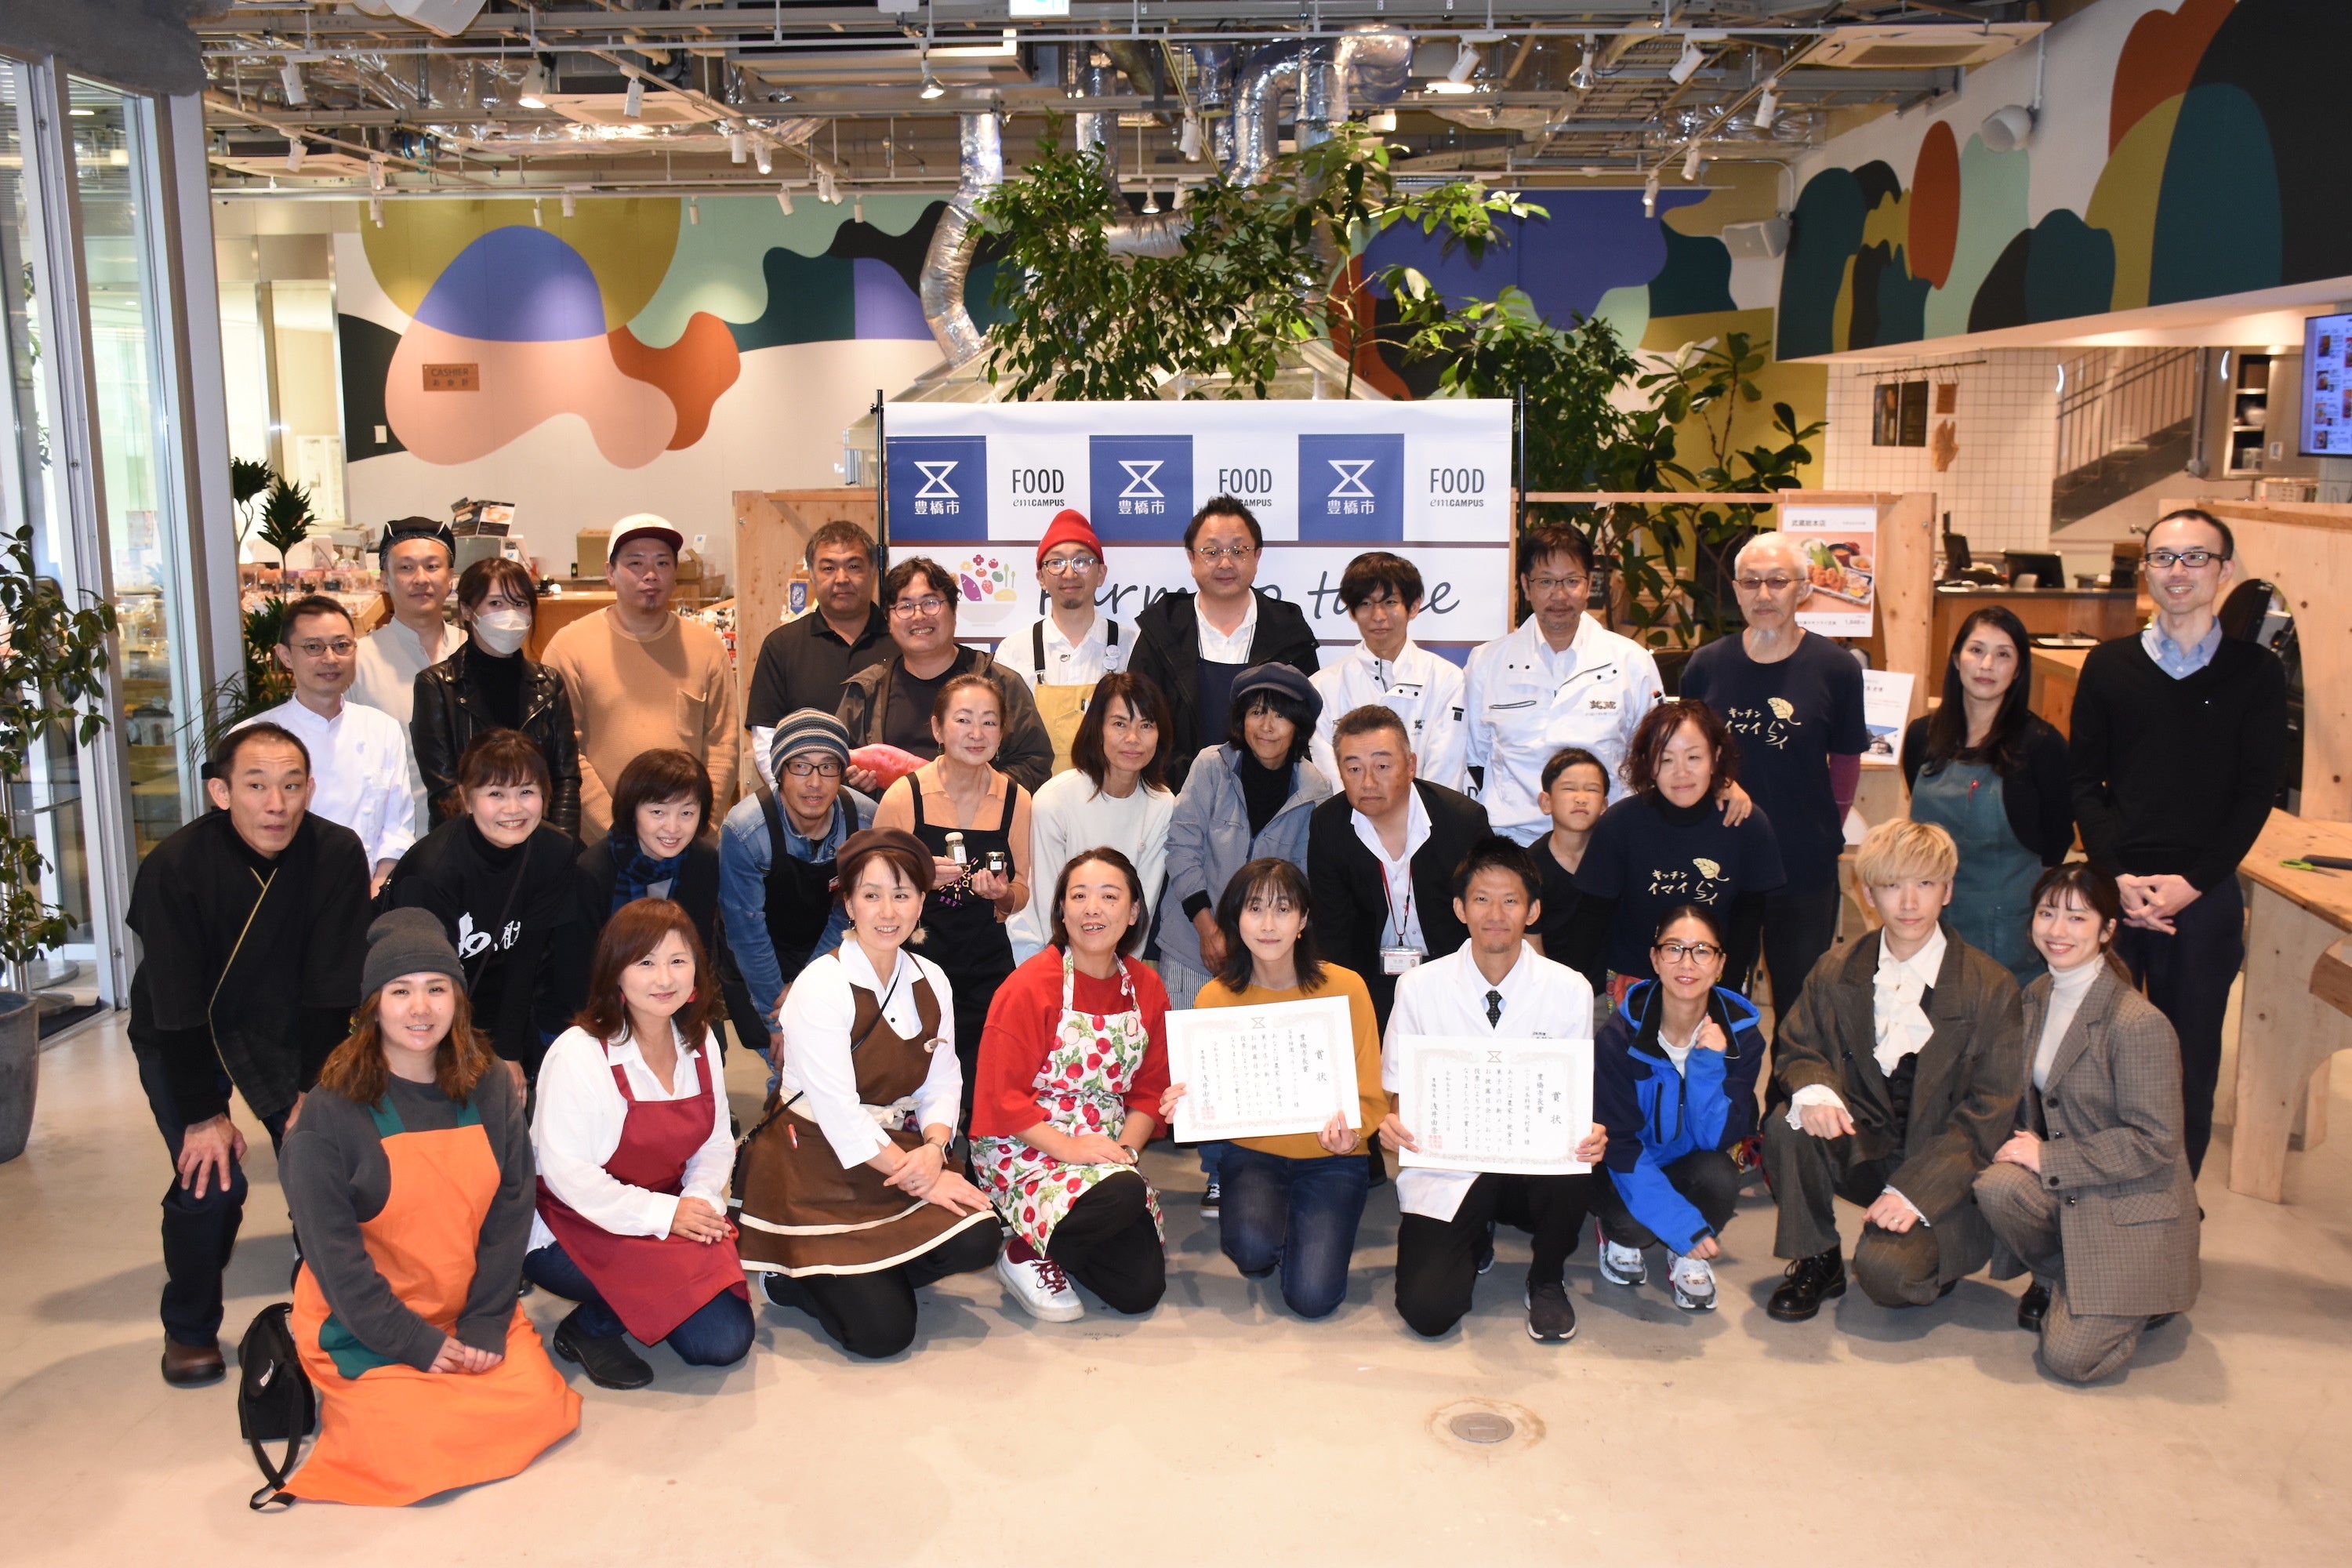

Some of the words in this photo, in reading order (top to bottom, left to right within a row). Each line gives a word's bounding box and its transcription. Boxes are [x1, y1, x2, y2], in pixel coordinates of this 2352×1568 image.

[431, 368, 469, 376] CASHIER
[1012, 469, 1065, 494] FOOD
[1219, 468, 1272, 494] FOOD
[1430, 468, 1484, 494] FOOD
[914, 499, 960, 515] 豊橋市
[1013, 498, 1065, 507] emCAMPUS
[1118, 499, 1166, 515] 豊橋市
[1327, 499, 1374, 515] 豊橋市
[1429, 499, 1484, 507] emCAMPUS
[1728, 706, 1762, 719] キッチン
[1725, 721, 1762, 735] イマイ
[1652, 869, 1688, 881] キッチン
[1648, 881, 1688, 895] イマイ
[1299, 1033, 1308, 1073] 豊橋市長賞
[1315, 1049, 1327, 1082] 賞状
[1551, 1091, 1562, 1125] 賞状
